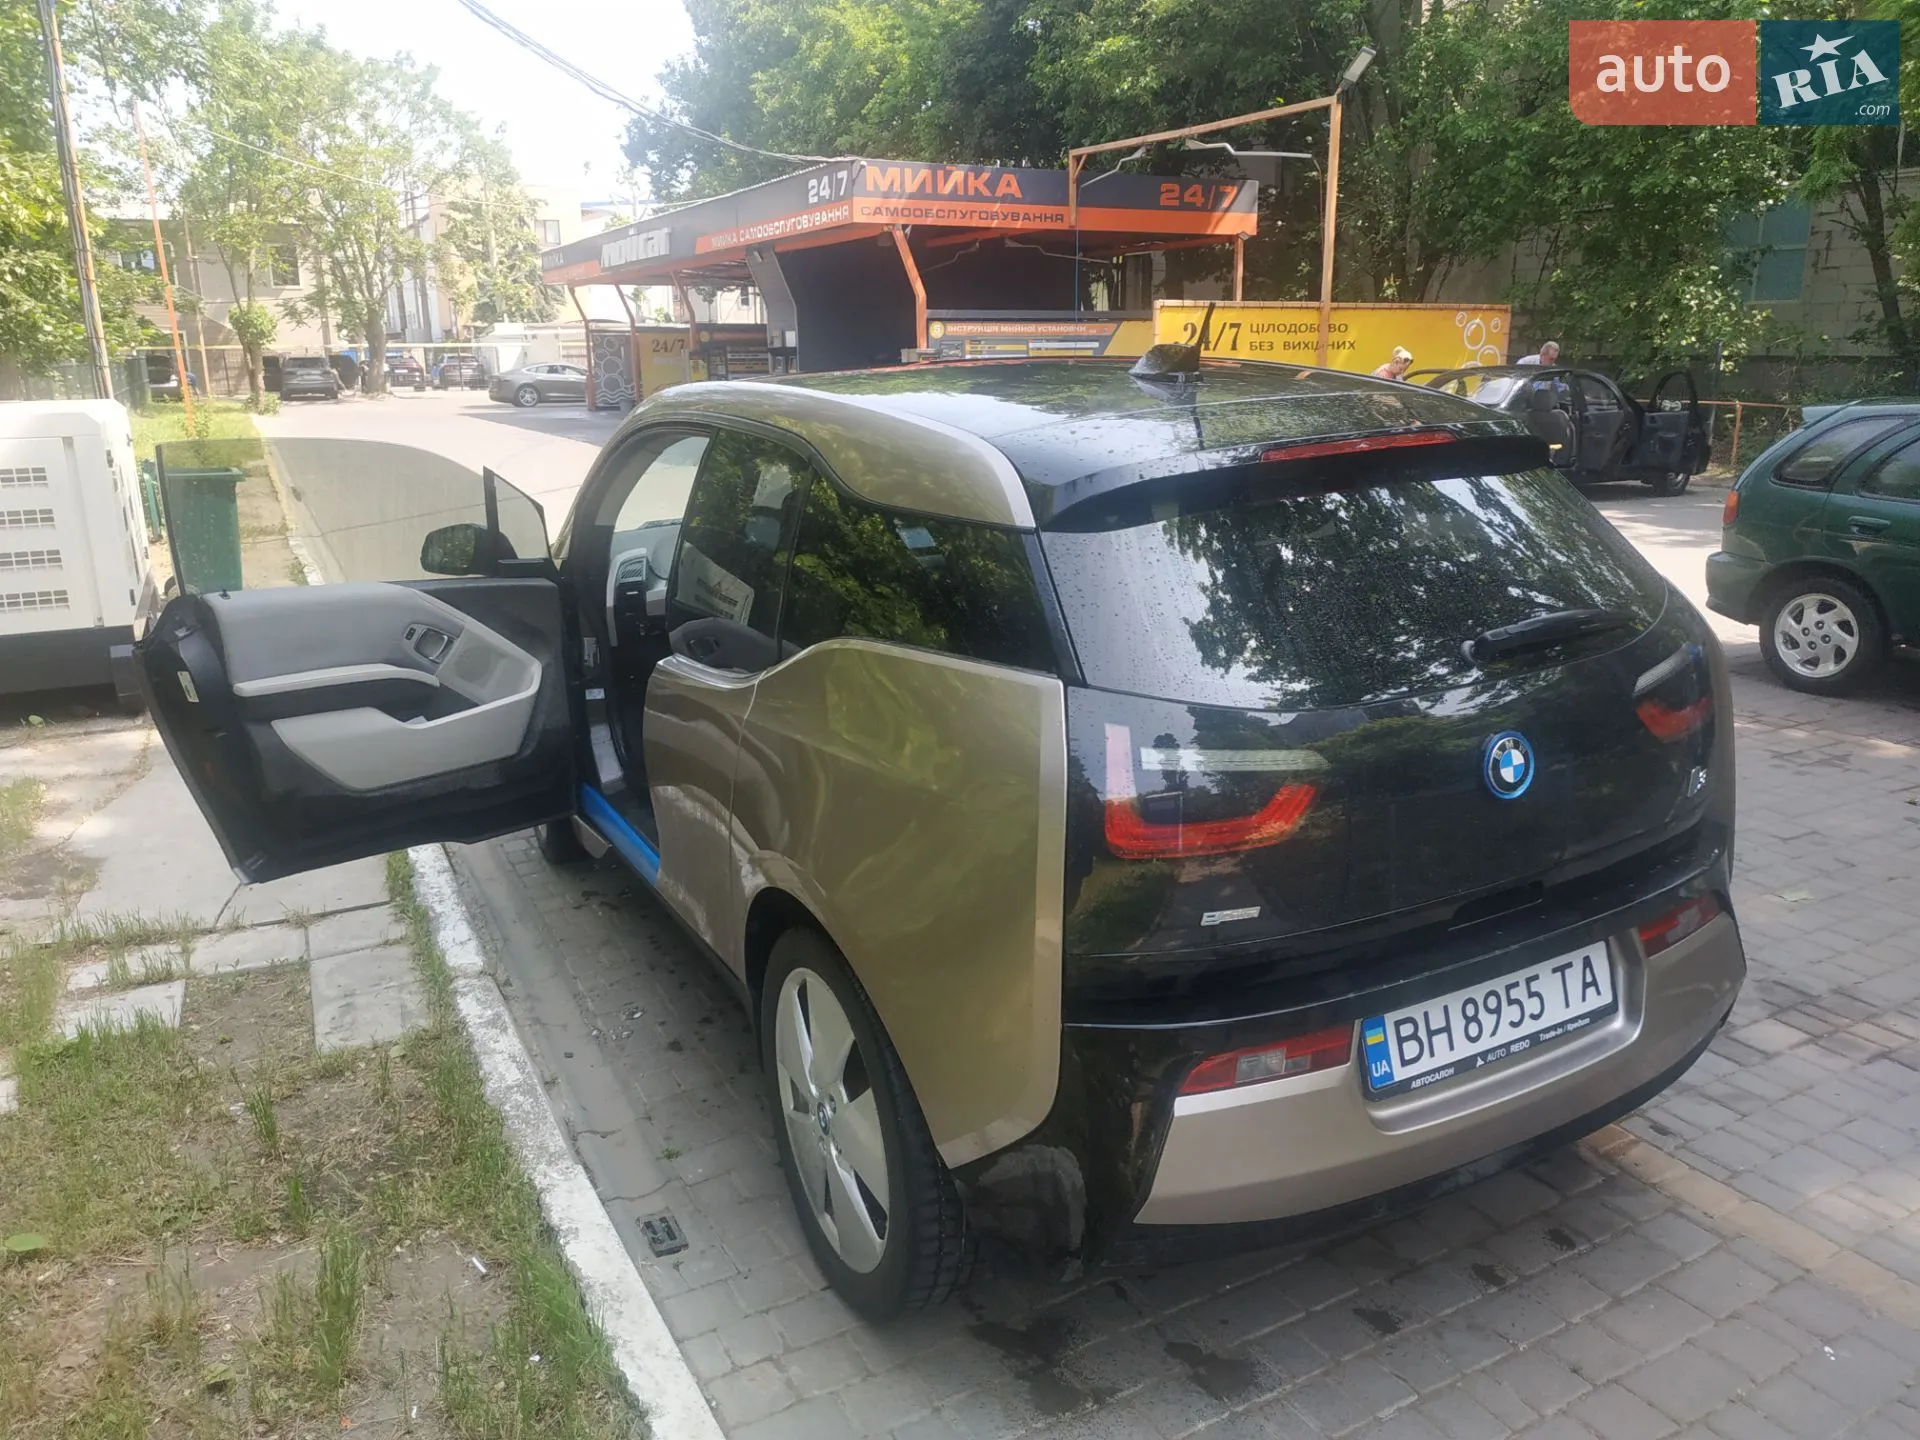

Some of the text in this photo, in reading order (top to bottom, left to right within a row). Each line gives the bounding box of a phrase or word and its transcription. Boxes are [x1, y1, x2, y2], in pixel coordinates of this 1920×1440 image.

[808, 170, 848, 204] 24/7
[865, 165, 1239, 210] МИЙКА 24/7
[739, 205, 849, 242] САМООБСЛУГОВУВАННЯ
[860, 205, 1065, 225] САМООБСЛУГОВУВАННЯ
[652, 339, 685, 353] 24/7
[1249, 340, 1275, 351] БЕЗ
[1393, 954, 1602, 1068] BH 8955 TA
[1487, 1039, 1530, 1063] AUTO REDO
[1372, 1059, 1391, 1077] UA
[1410, 1067, 1455, 1089] АВТОСАЛОН
